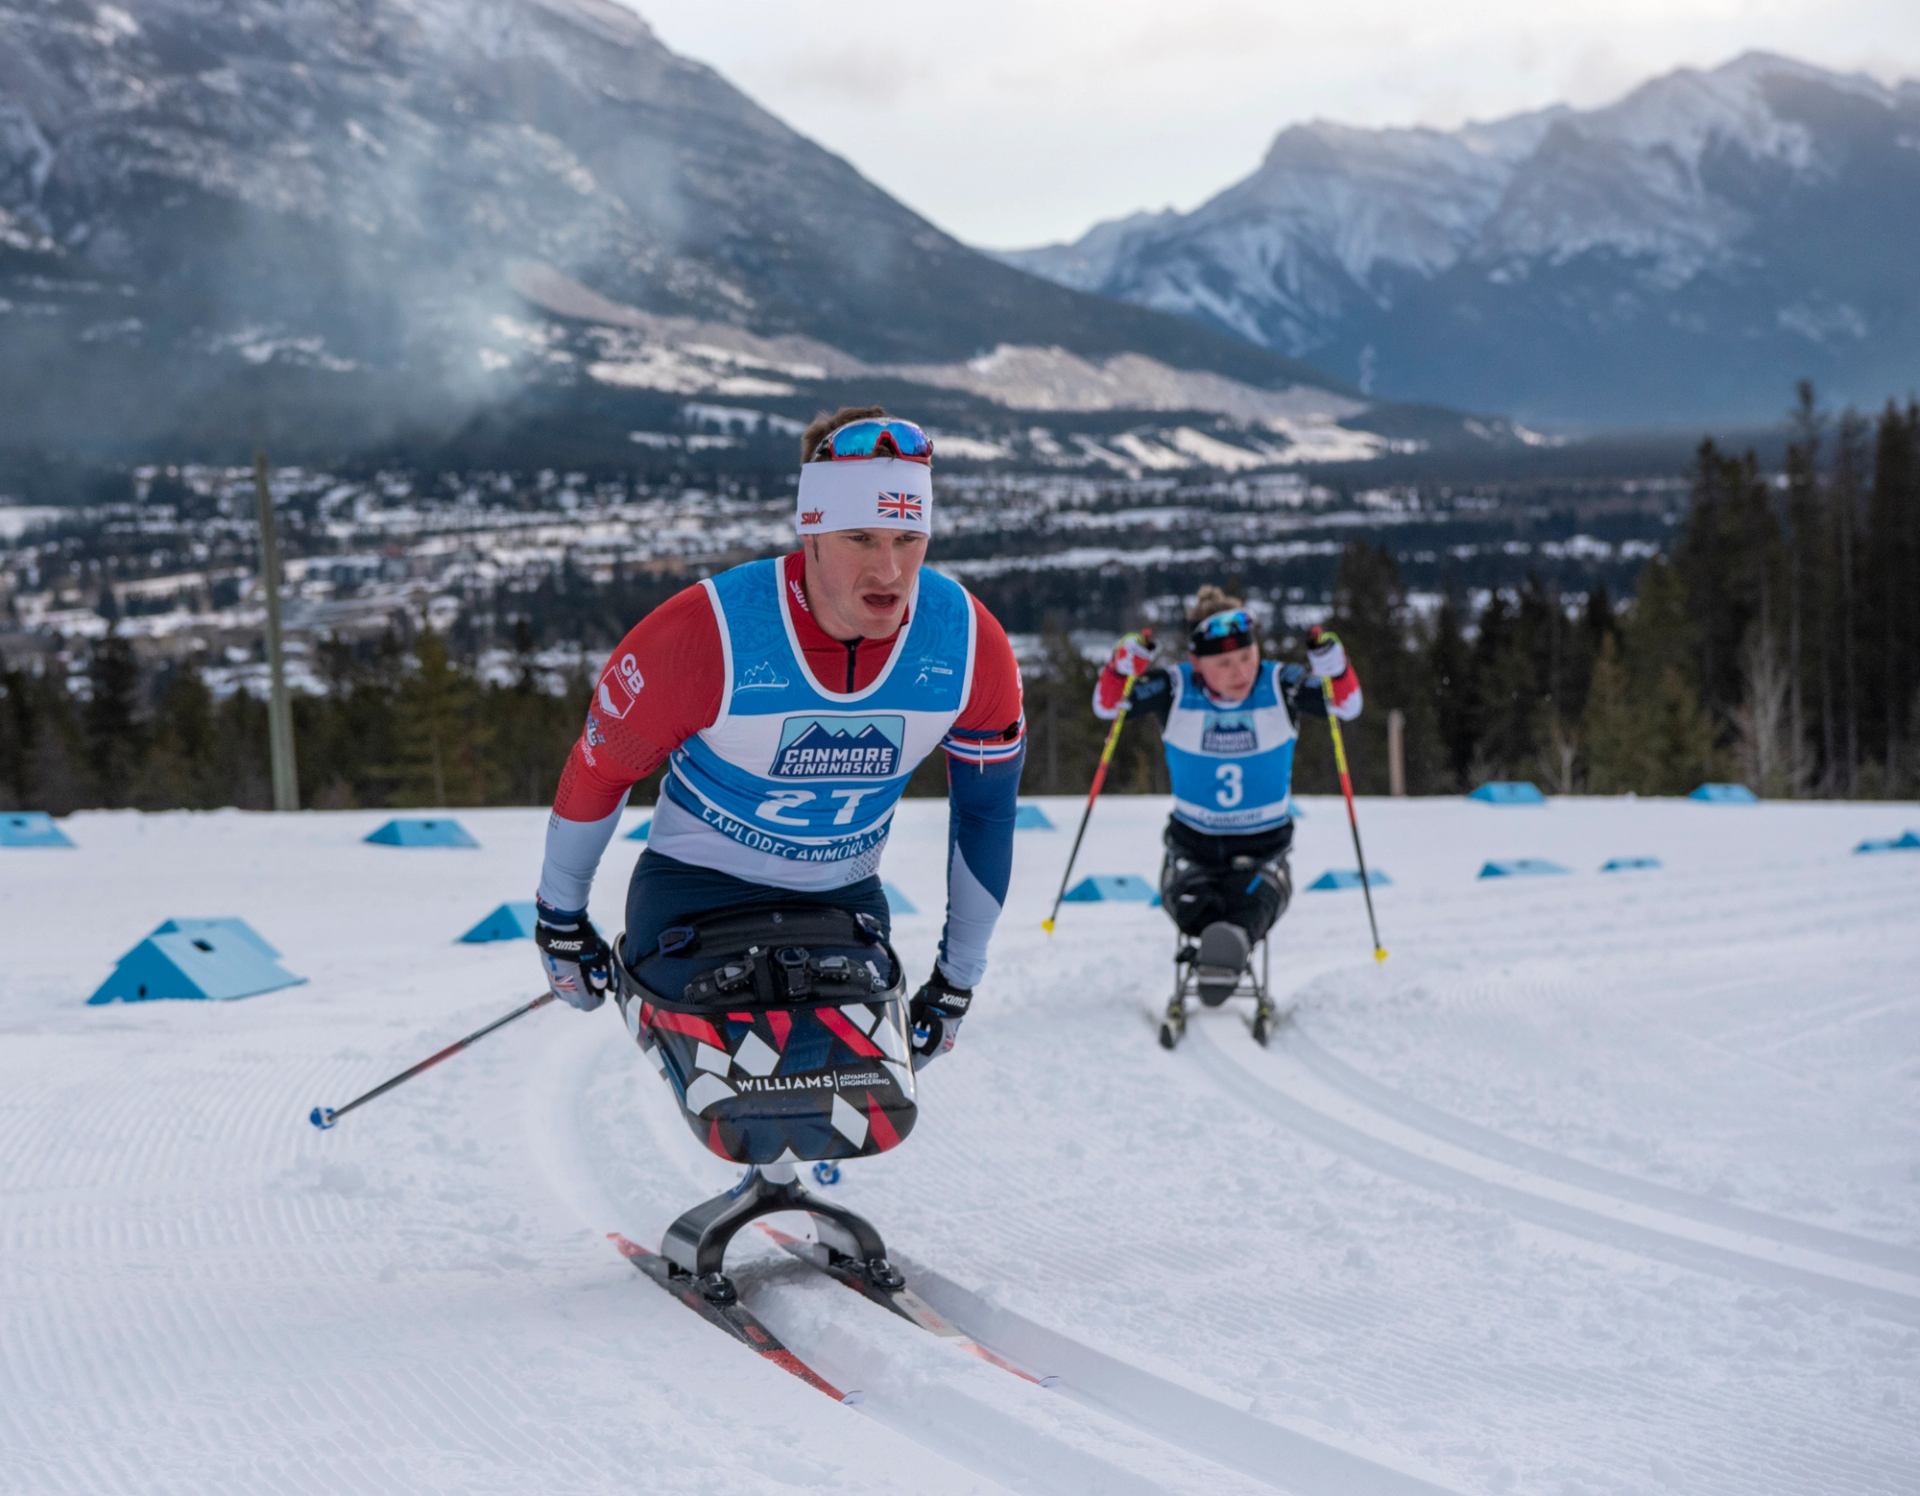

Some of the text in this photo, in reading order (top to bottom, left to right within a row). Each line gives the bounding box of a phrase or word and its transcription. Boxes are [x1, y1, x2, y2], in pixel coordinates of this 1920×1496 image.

[620, 653, 645, 695] GB
[783, 748, 893, 763] CANMORE
[780, 762, 890, 775] KANANASKIS
[1216, 764, 1243, 808] 3
[736, 1075, 834, 1092] WILLIAMS
[839, 1072, 880, 1081] ADVANCED
[840, 1078, 891, 1087] ENGINEERING
